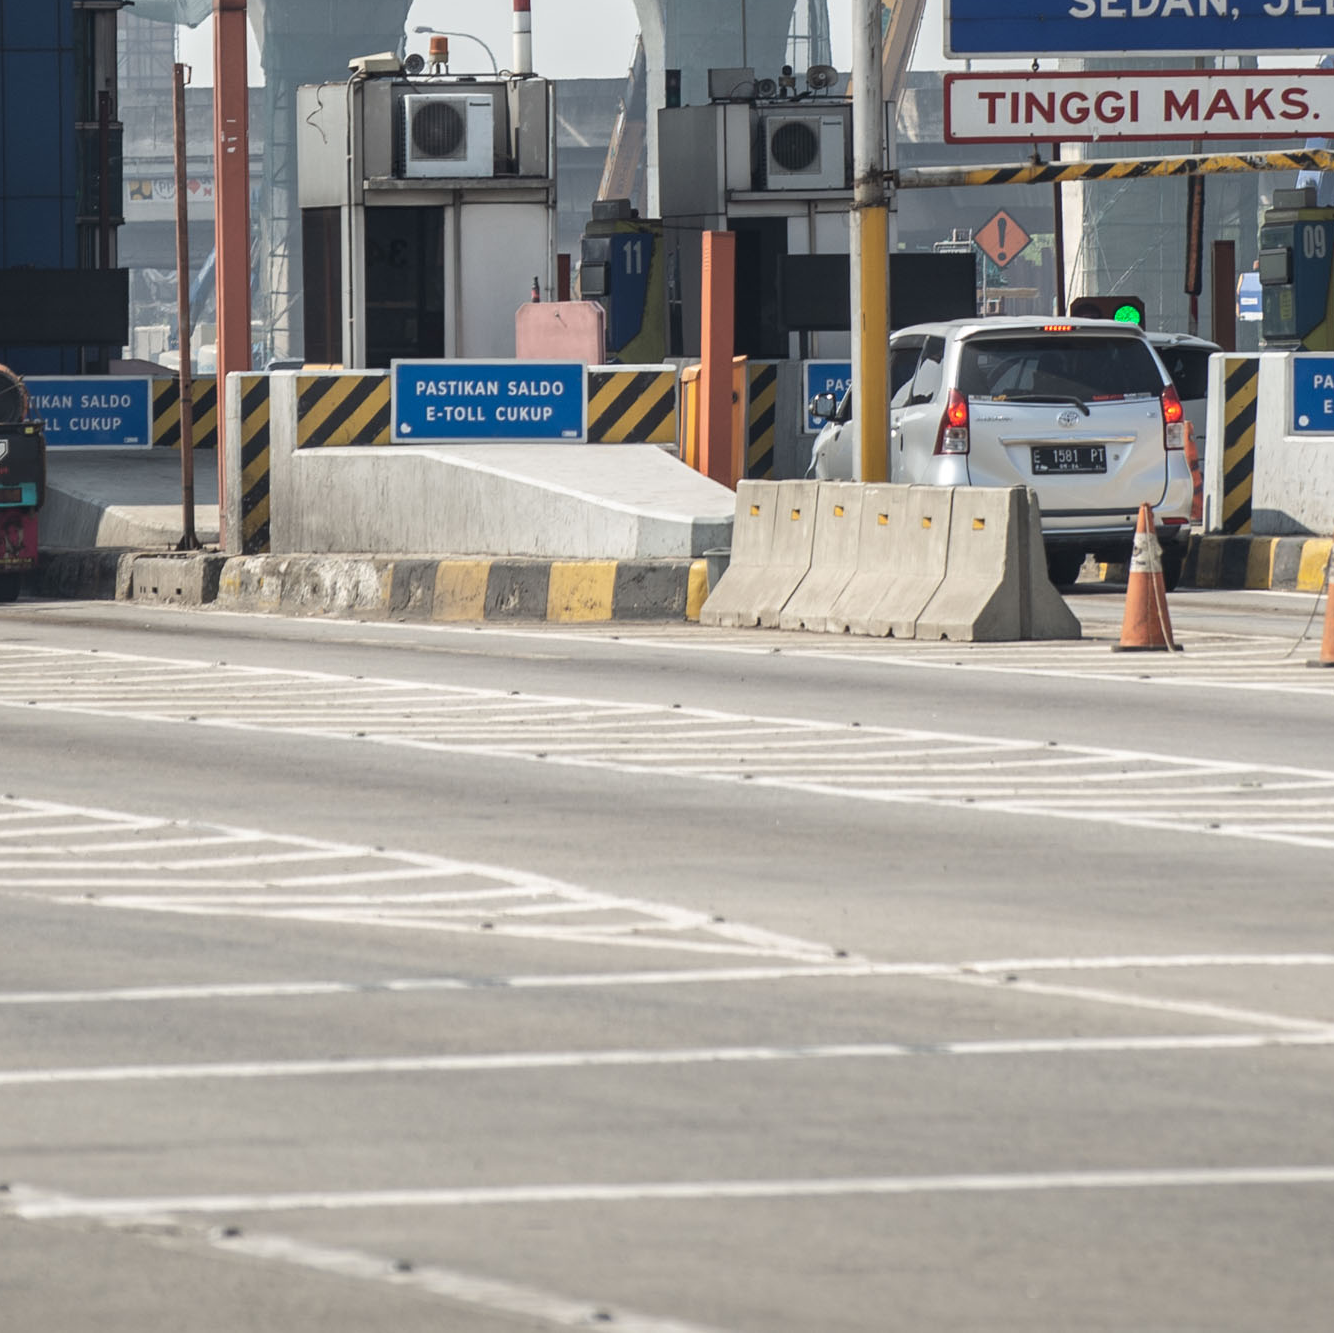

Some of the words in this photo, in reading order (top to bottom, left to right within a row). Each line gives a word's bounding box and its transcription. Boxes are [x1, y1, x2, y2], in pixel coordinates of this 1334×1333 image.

[978, 90, 1140, 125] TINGGI
[1164, 87, 1321, 122] MAKS.
[1302, 225, 1327, 259] 09
[622, 240, 642, 275] 11
[415, 380, 499, 396] PASTIKAN
[507, 380, 565, 396] SALDO
[80, 394, 132, 409] SALDO
[425, 406, 486, 422] E-TOLL
[495, 406, 553, 422] CUKUP
[69, 417, 123, 432] CUKUP
[1033, 449, 1041, 464] E
[1053, 448, 1079, 463] 1581
[1090, 447, 1105, 463] PT
